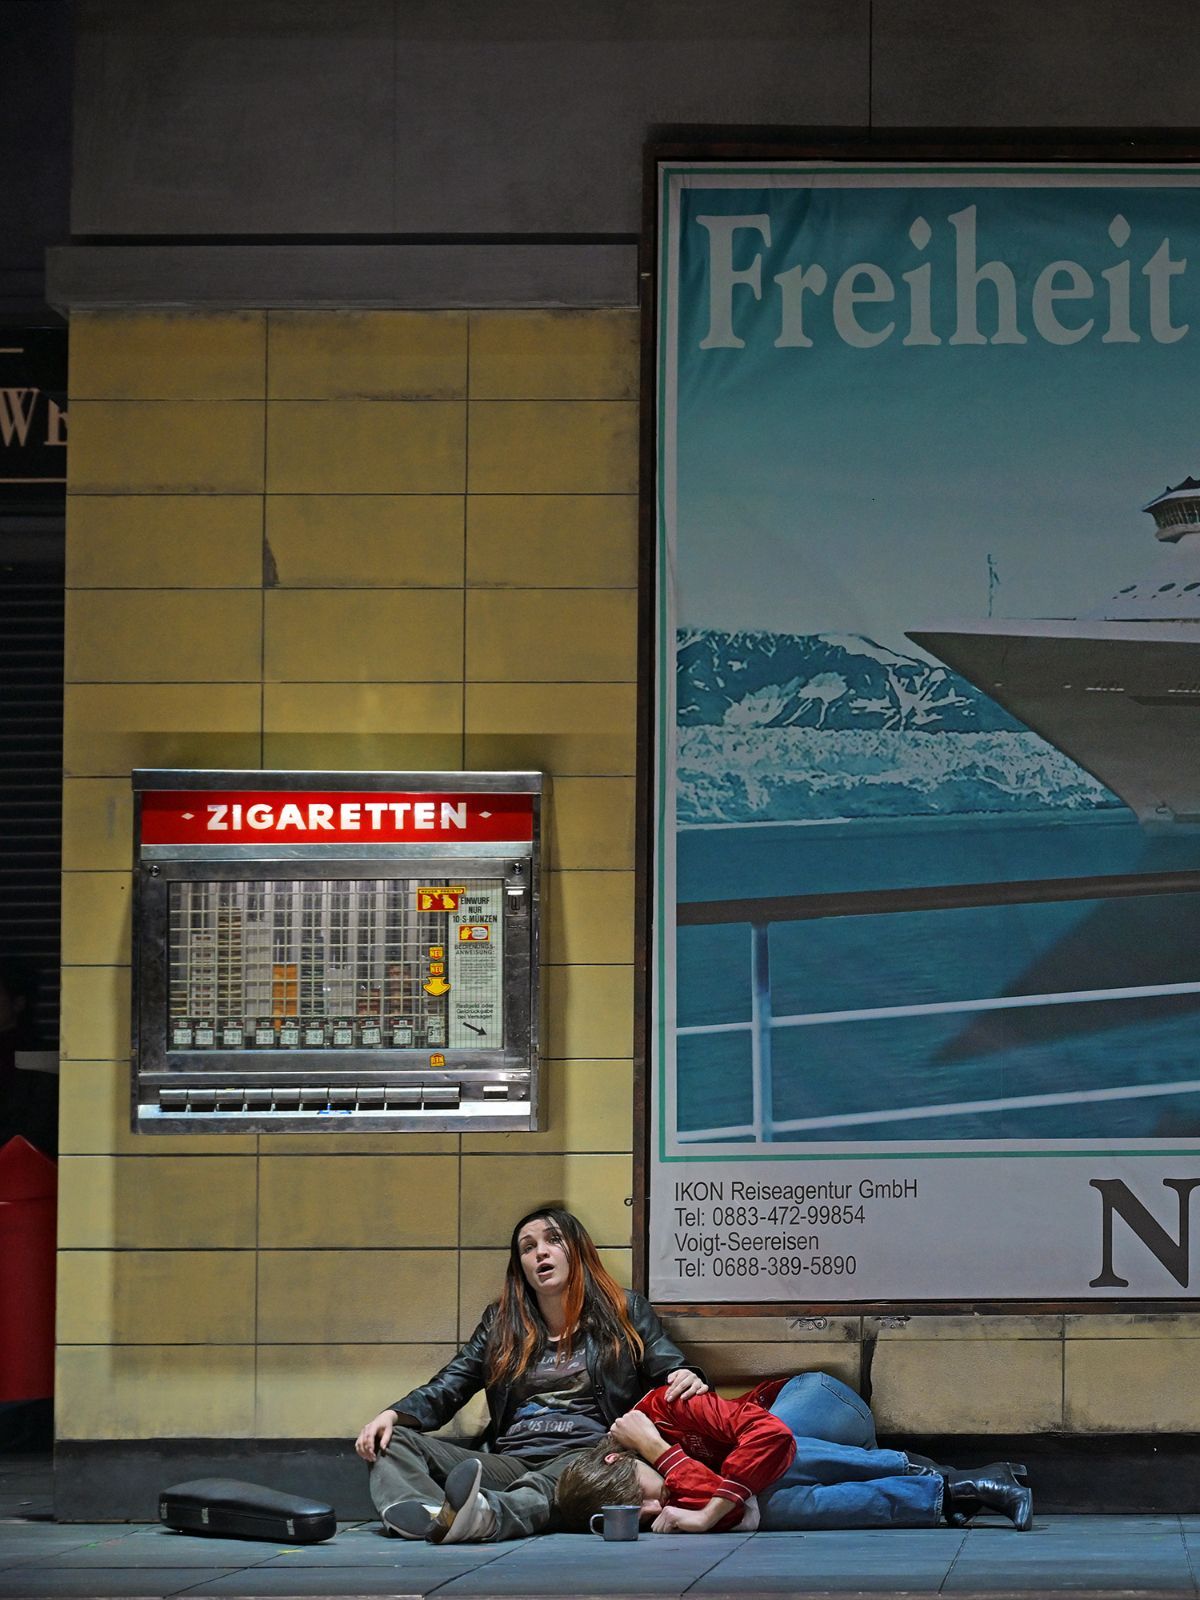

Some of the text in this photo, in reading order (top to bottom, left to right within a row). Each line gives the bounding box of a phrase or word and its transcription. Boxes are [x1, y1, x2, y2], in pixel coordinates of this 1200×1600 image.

[695, 203, 1191, 351] Freiheit
[206, 801, 468, 831] ZIGARETTEN
[460, 896, 490, 905] EINWURF
[468, 906, 482, 914] NUR
[674, 1179, 918, 1205] IKON Reiseagentur GmbH
[674, 1205, 866, 1227] Tel: 0883-472-99854
[674, 1231, 820, 1257] Voigt-Seereisen
[674, 1255, 857, 1278] Tel: 0688-389-5890
[527, 1420, 543, 1432] US
[544, 1421, 575, 1433] TOUR
